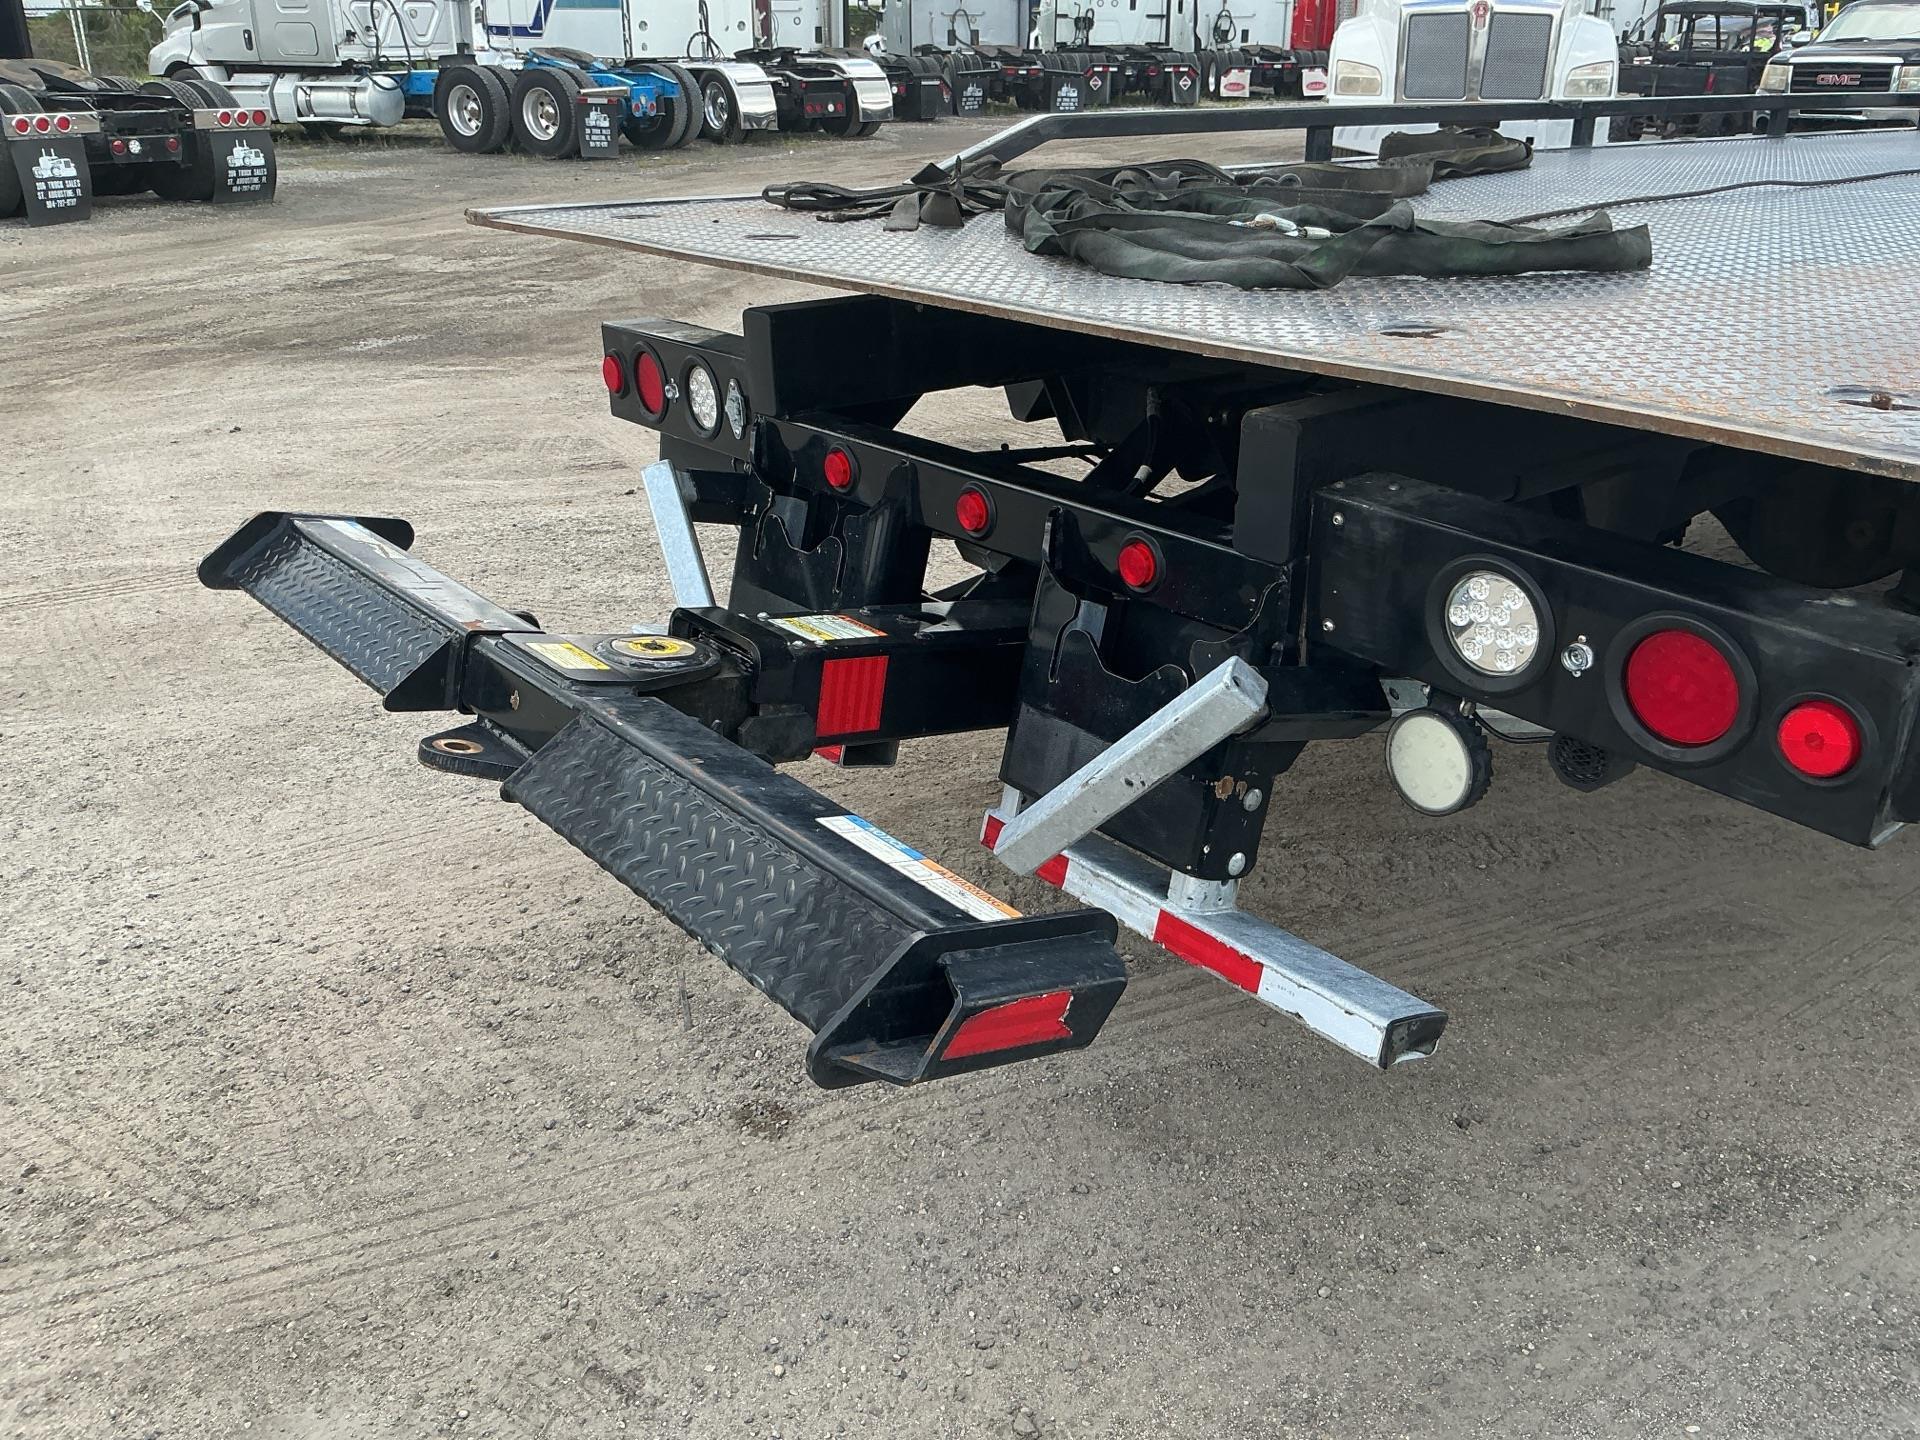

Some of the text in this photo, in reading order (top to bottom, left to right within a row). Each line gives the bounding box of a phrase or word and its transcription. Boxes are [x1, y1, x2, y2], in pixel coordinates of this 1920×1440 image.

[1816, 74, 1861, 86] GMC
[47, 181, 64, 189] TRUCK
[947, 873, 1001, 907] WARNING
